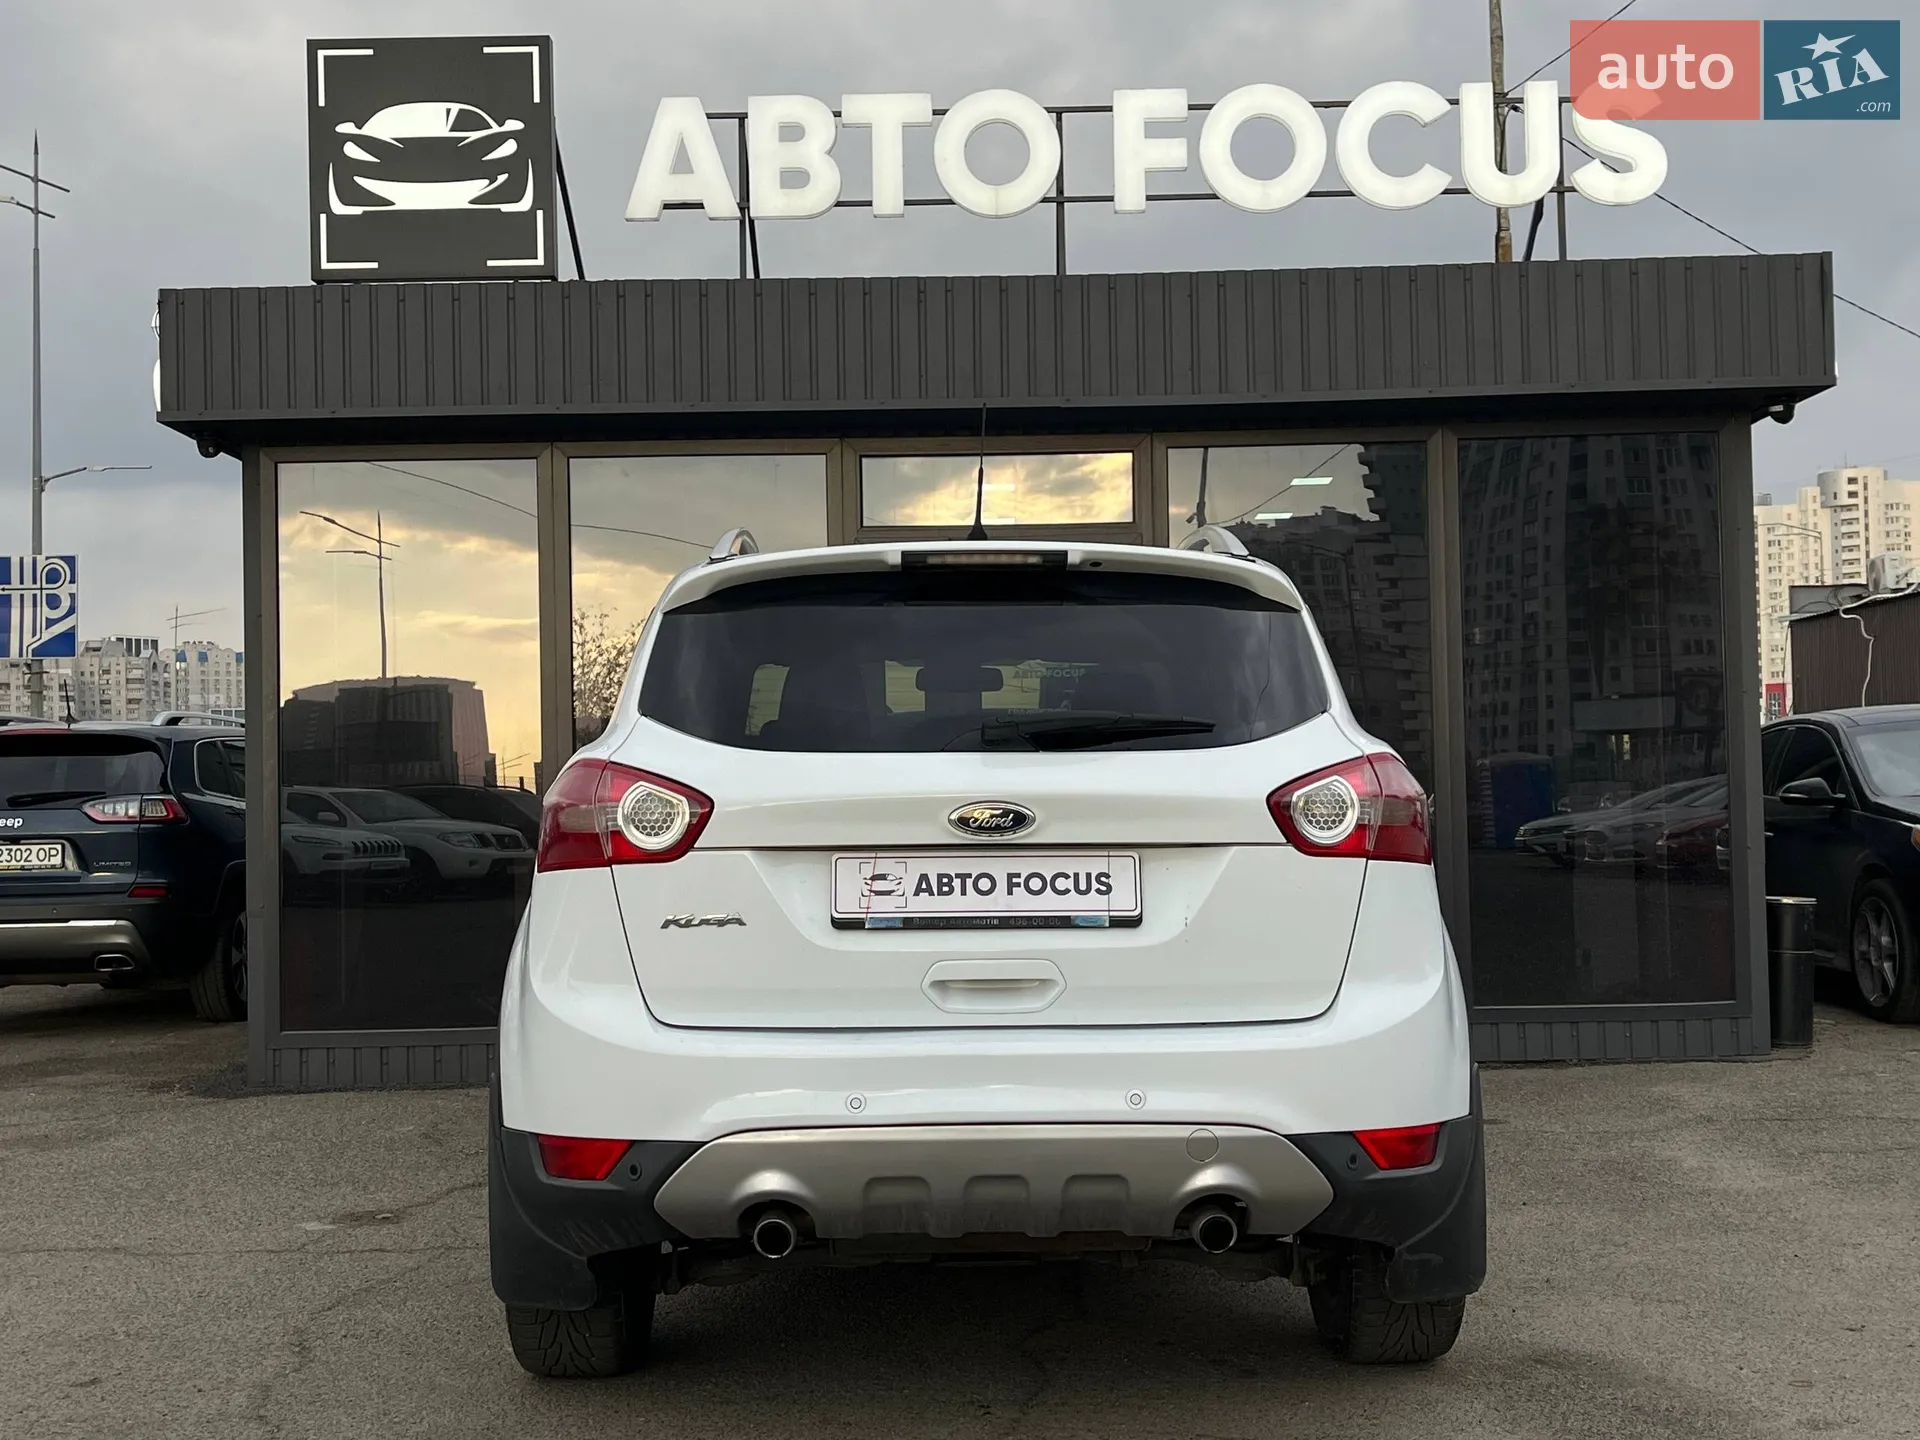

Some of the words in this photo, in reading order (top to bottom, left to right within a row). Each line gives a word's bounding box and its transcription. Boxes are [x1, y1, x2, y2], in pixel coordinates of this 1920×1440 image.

[624, 88, 1062, 222] АВТО
[1113, 80, 1669, 214] FOCUS
[0, 817, 23, 829] eep
[969, 808, 1015, 828] Ford
[36, 846, 59, 863] OP
[912, 872, 998, 897] АВТО
[1006, 872, 1113, 897] FOCUS
[660, 911, 748, 930] KUGA
